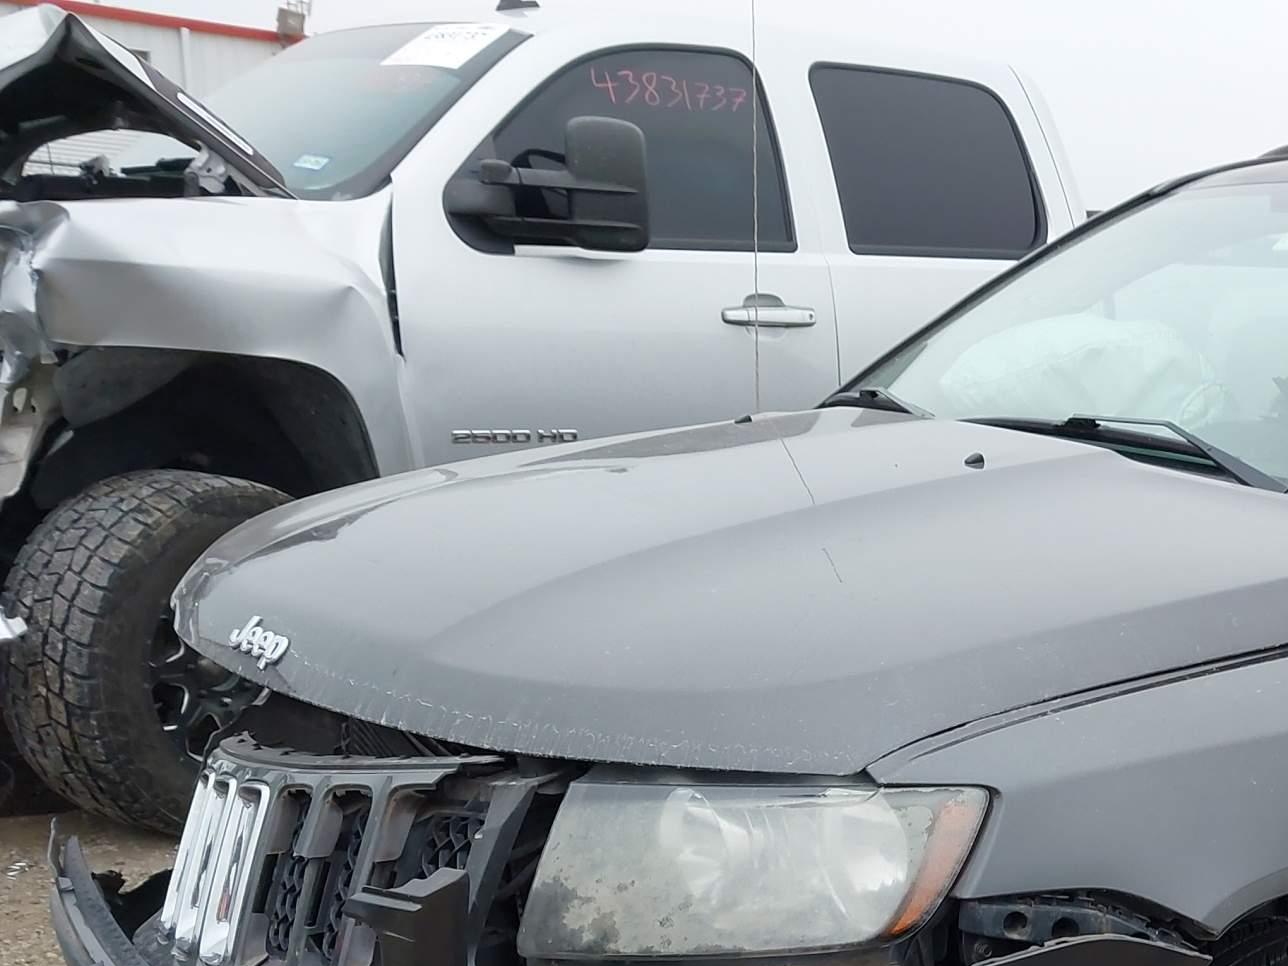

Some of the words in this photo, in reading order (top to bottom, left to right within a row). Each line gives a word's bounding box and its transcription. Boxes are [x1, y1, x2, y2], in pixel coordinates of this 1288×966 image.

[589, 65, 747, 112] 43831737
[451, 429, 531, 444] 2500
[537, 428, 578, 443] HD
[228, 615, 290, 670] Jeep
